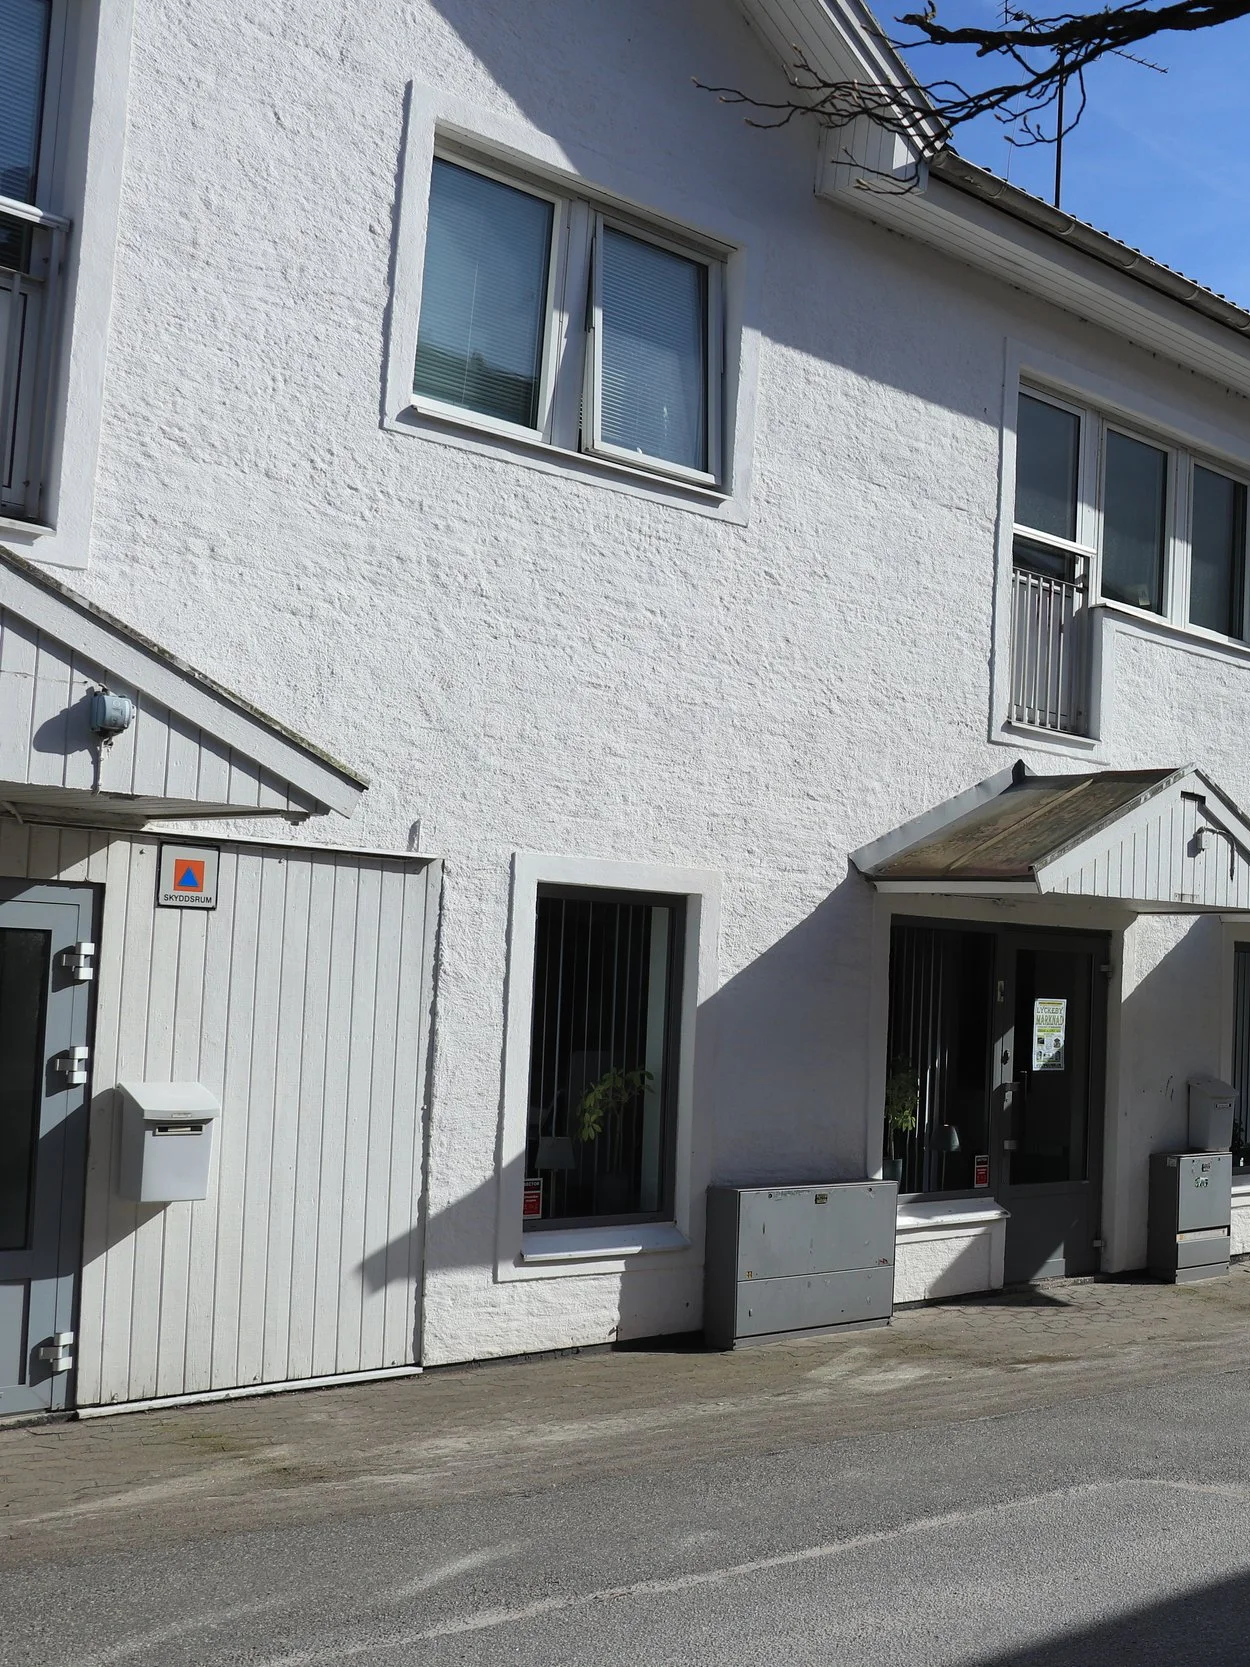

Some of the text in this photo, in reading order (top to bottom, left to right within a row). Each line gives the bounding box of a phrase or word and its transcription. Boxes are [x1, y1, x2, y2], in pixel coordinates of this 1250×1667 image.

[163, 893, 212, 904] SKYDDSRUM
[1037, 1006, 1064, 1015] LYCKEBY
[1036, 1015, 1064, 1026] MARKNAD
